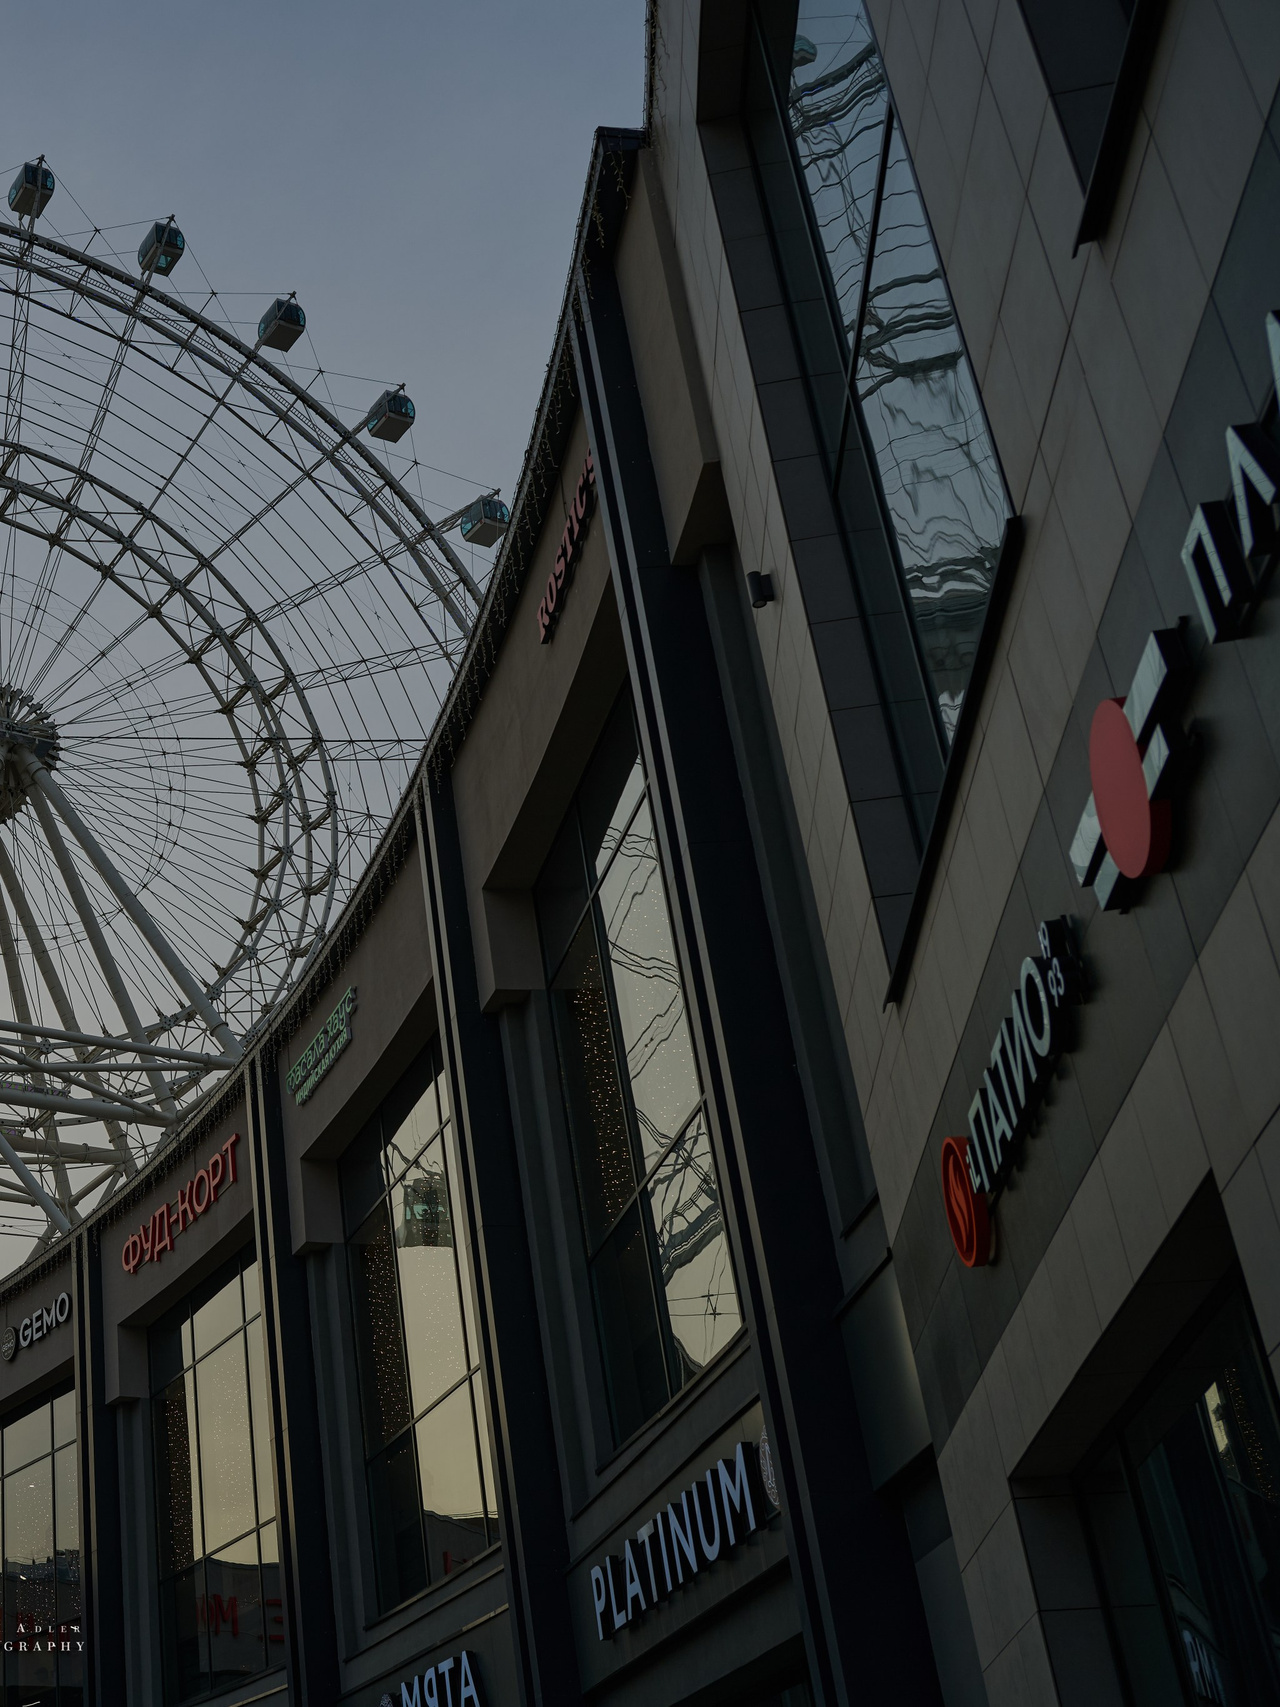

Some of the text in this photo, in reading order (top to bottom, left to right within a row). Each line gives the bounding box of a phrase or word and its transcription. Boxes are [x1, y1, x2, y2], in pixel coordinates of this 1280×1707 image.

[968, 956, 1052, 1193] ПАТИО
[122, 1133, 239, 1274] ФУД-КОРТ
[20, 1292, 69, 1347] GEMO
[590, 1441, 757, 1642] PLATINUM
